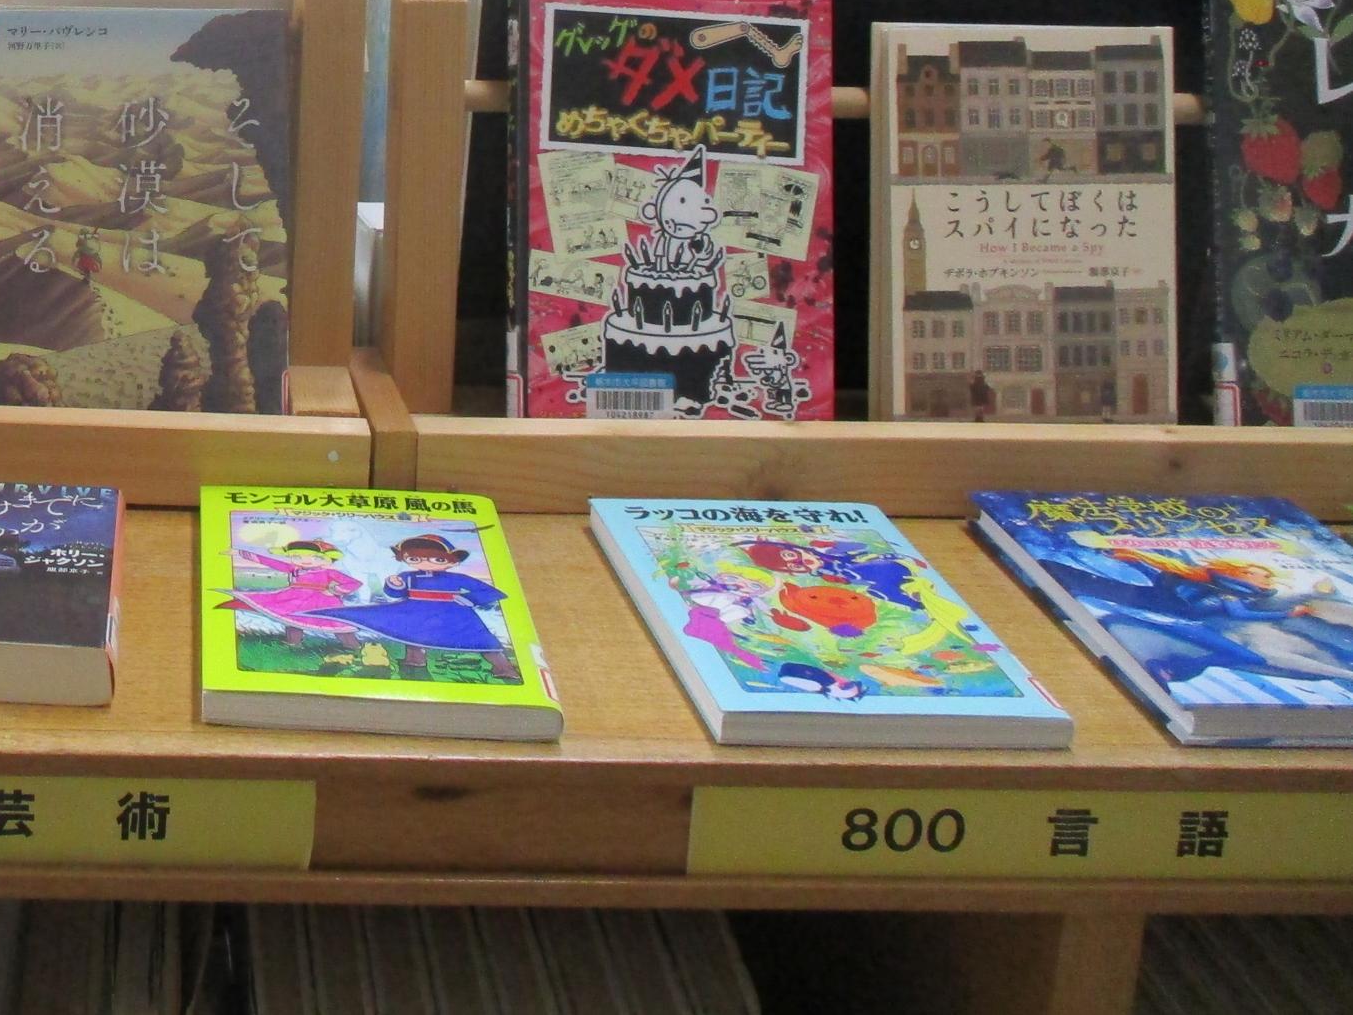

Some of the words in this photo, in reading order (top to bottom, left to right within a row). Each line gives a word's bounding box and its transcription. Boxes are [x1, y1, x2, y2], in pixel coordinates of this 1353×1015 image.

[556, 17, 657, 57] グレッグの
[603, 35, 792, 121] ダメ日記
[556, 107, 792, 159] めちゃくちゃパーティー
[18, 96, 65, 274] 消える
[116, 96, 171, 274] 砂漠は
[223, 96, 261, 273] そして
[946, 189, 1139, 213] こうしてぼくは
[944, 216, 1138, 238] スパイになった
[979, 242, 1008, 254] How
[1021, 242, 1067, 253] Became
[1082, 242, 1105, 256] Spy
[224, 491, 399, 511] モンゴル大草原
[404, 496, 478, 515] 風の馬
[23, 554, 104, 568] ジャクソン
[840, 809, 966, 853] 800
